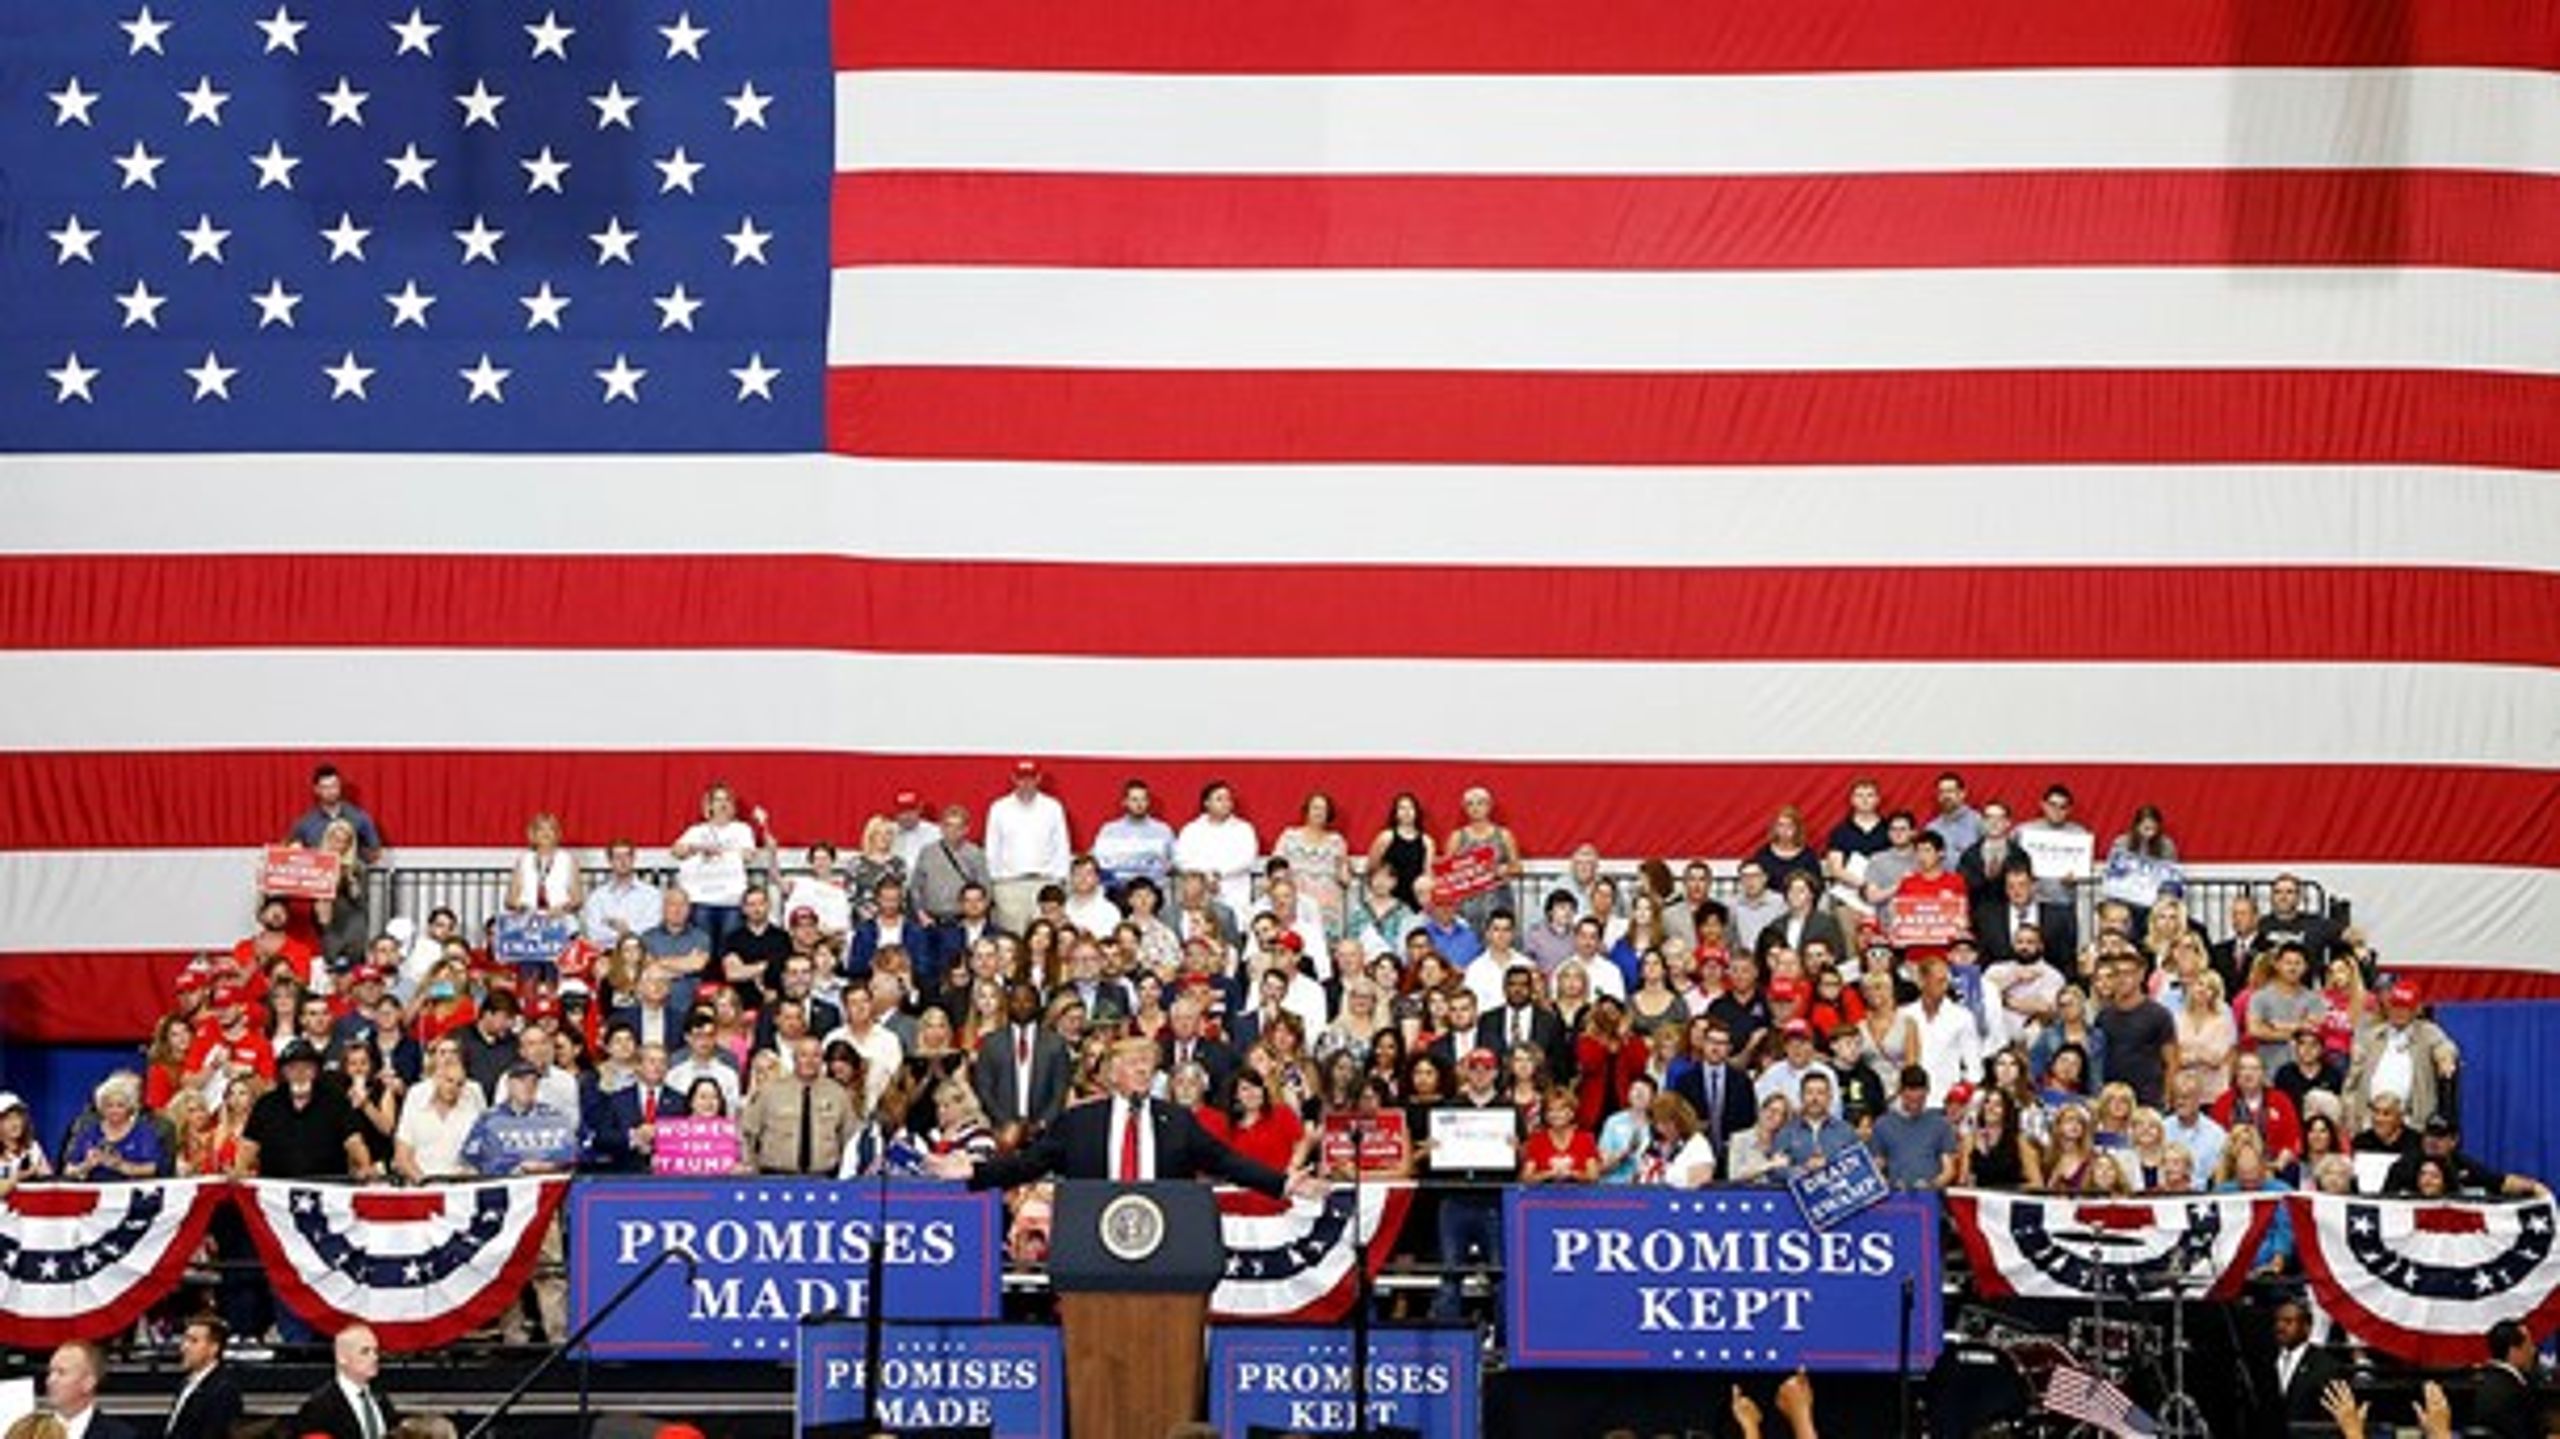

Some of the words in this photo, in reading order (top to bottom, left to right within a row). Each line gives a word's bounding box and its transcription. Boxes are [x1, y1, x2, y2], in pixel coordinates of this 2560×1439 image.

[660, 1156, 735, 1175] TRUMP
[617, 1219, 956, 1264] PROMISES
[1552, 1228, 1895, 1275] PROMISES
[1638, 1287, 1813, 1330] KEPT
[874, 1398, 993, 1427] MADE
